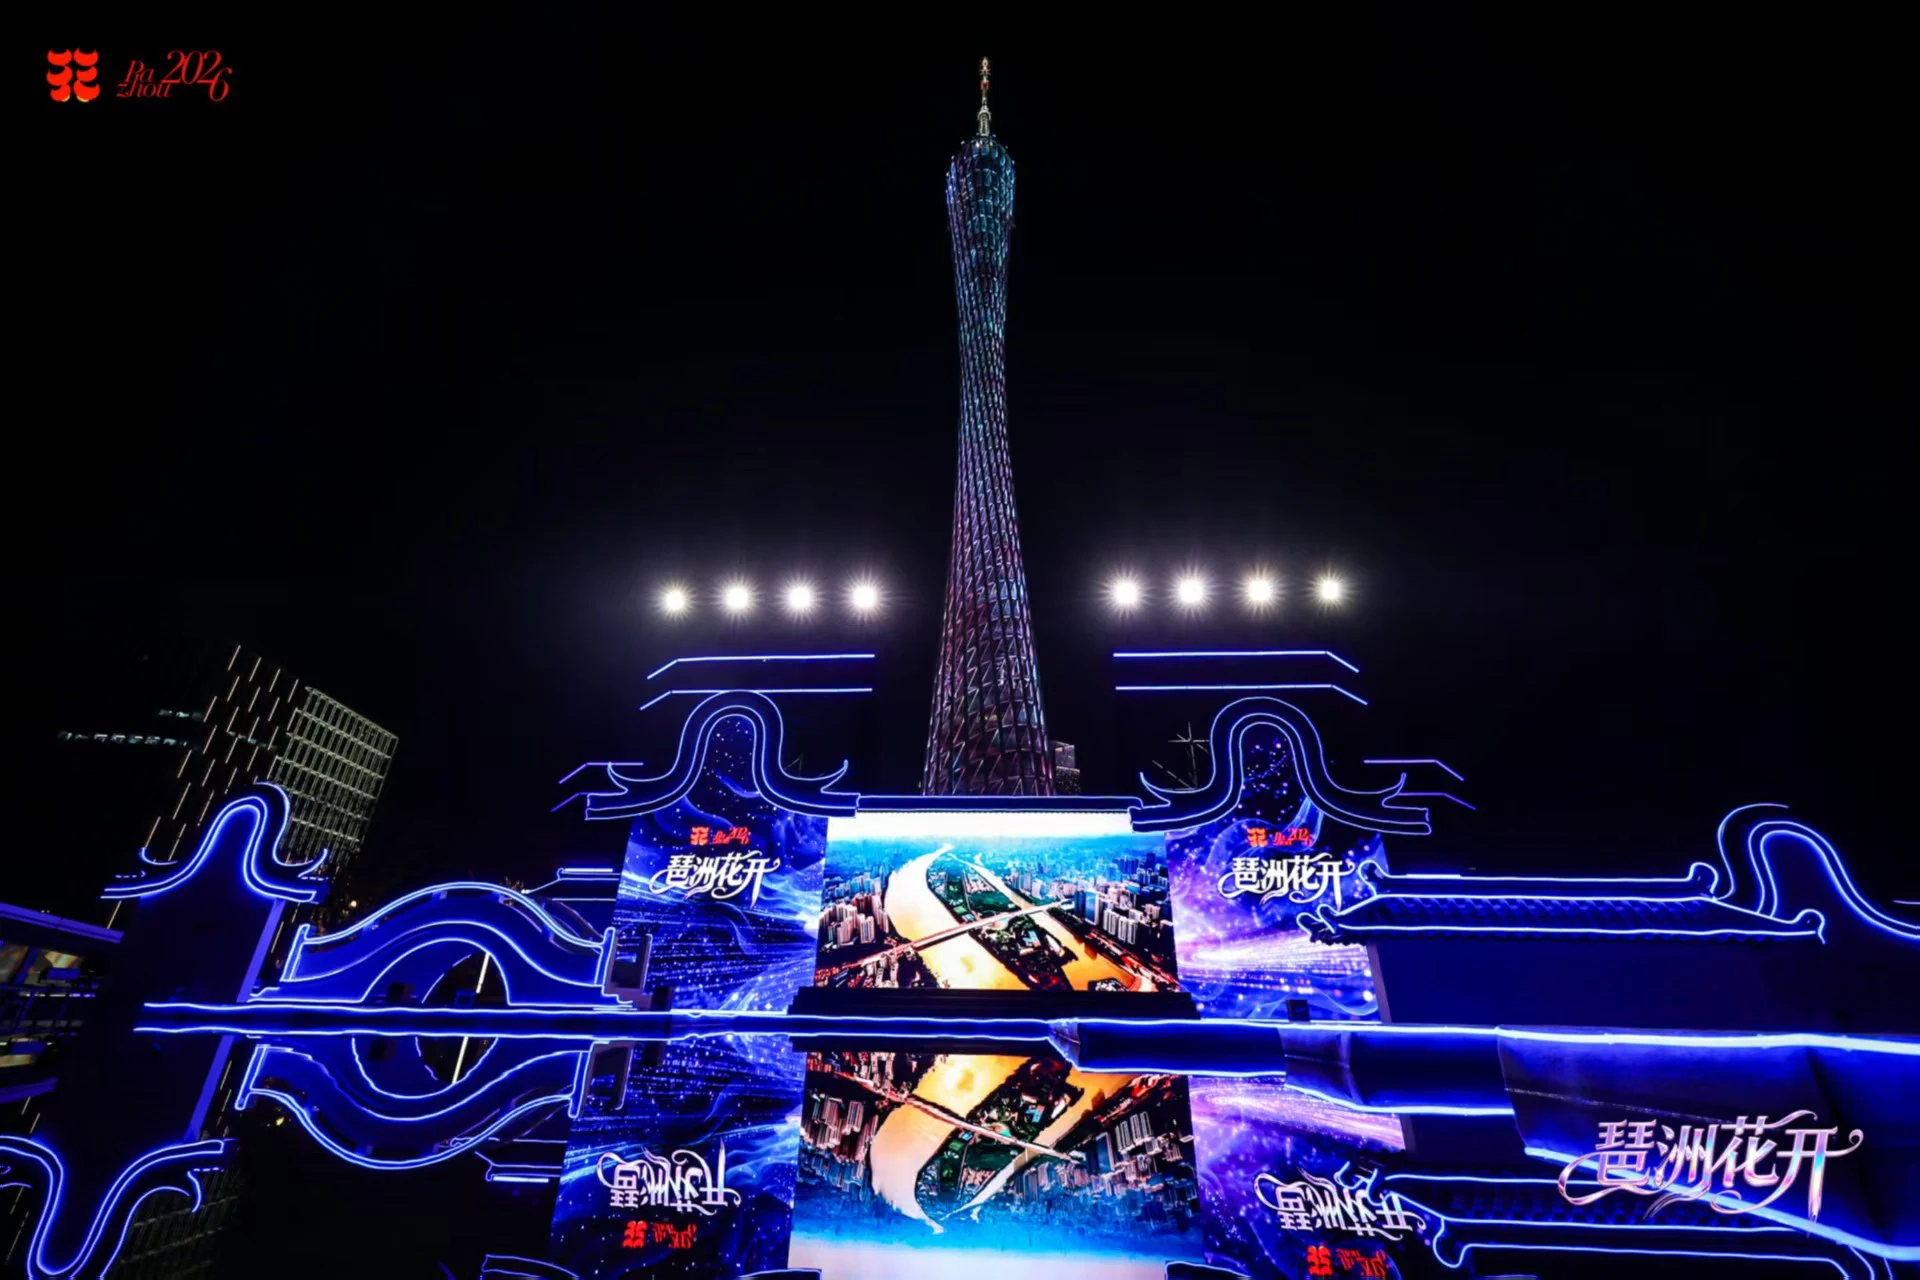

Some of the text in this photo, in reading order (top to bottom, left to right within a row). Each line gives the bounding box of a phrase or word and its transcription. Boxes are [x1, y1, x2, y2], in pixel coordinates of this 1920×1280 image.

[649, 850, 781, 910] 琶洲花开
[1217, 852, 1356, 911] 琶洲花开
